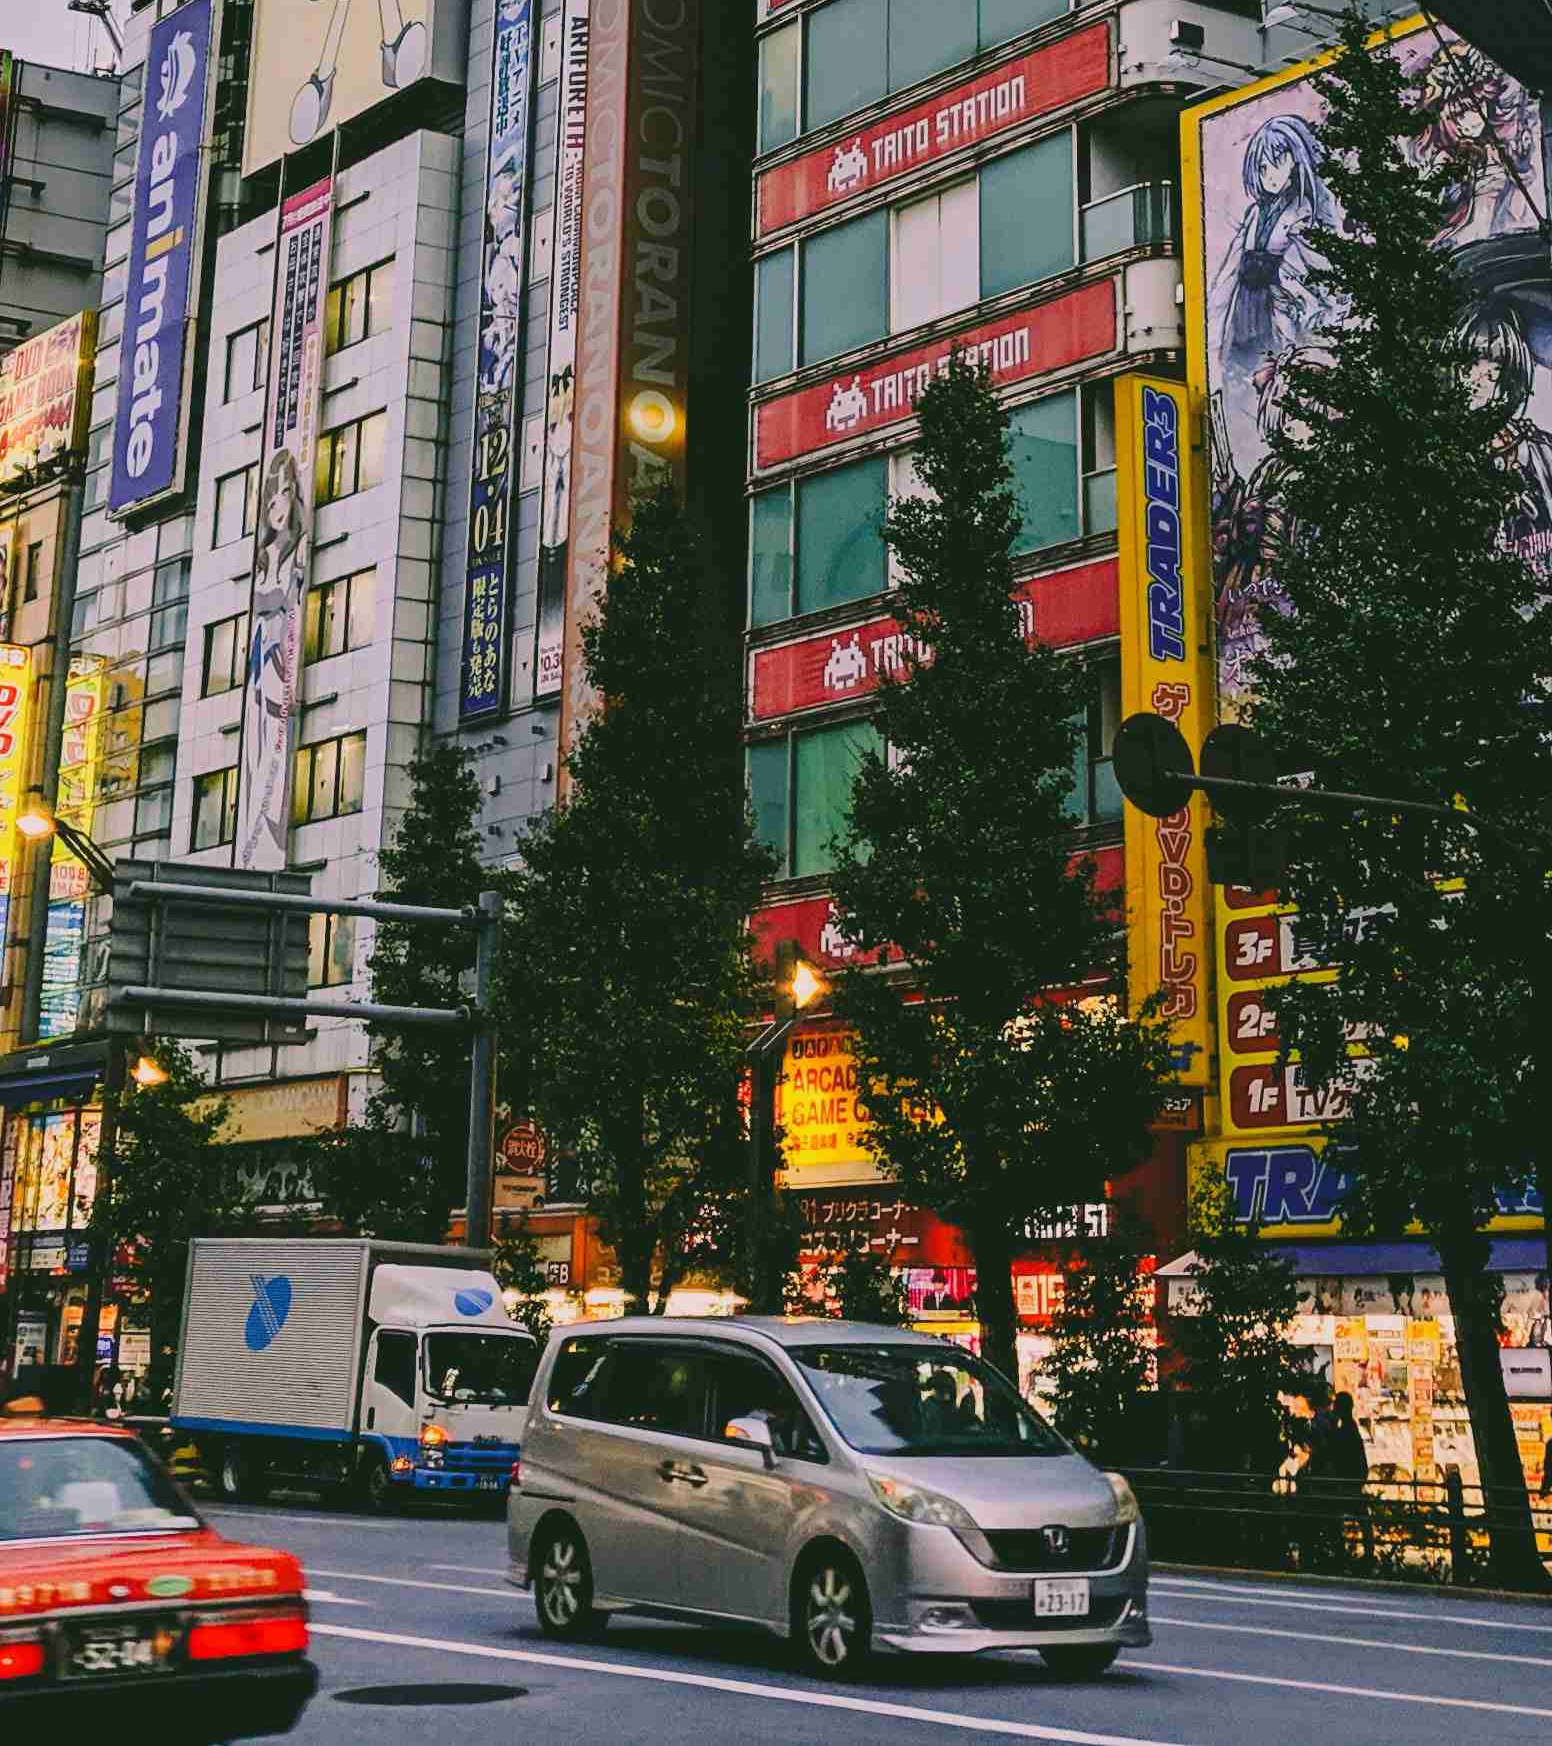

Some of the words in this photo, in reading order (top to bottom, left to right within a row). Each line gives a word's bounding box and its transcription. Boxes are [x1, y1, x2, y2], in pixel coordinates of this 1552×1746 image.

[872, 120, 929, 172] TAITO
[936, 74, 1026, 146] STATION
[127, 130, 184, 478] animate
[483, 573, 500, 693] とらのあな
[1235, 931, 1274, 966] 3F
[1236, 1004, 1276, 1039] 2F
[1247, 1078, 1280, 1113] 1F
[791, 1099, 848, 1128] GAME
